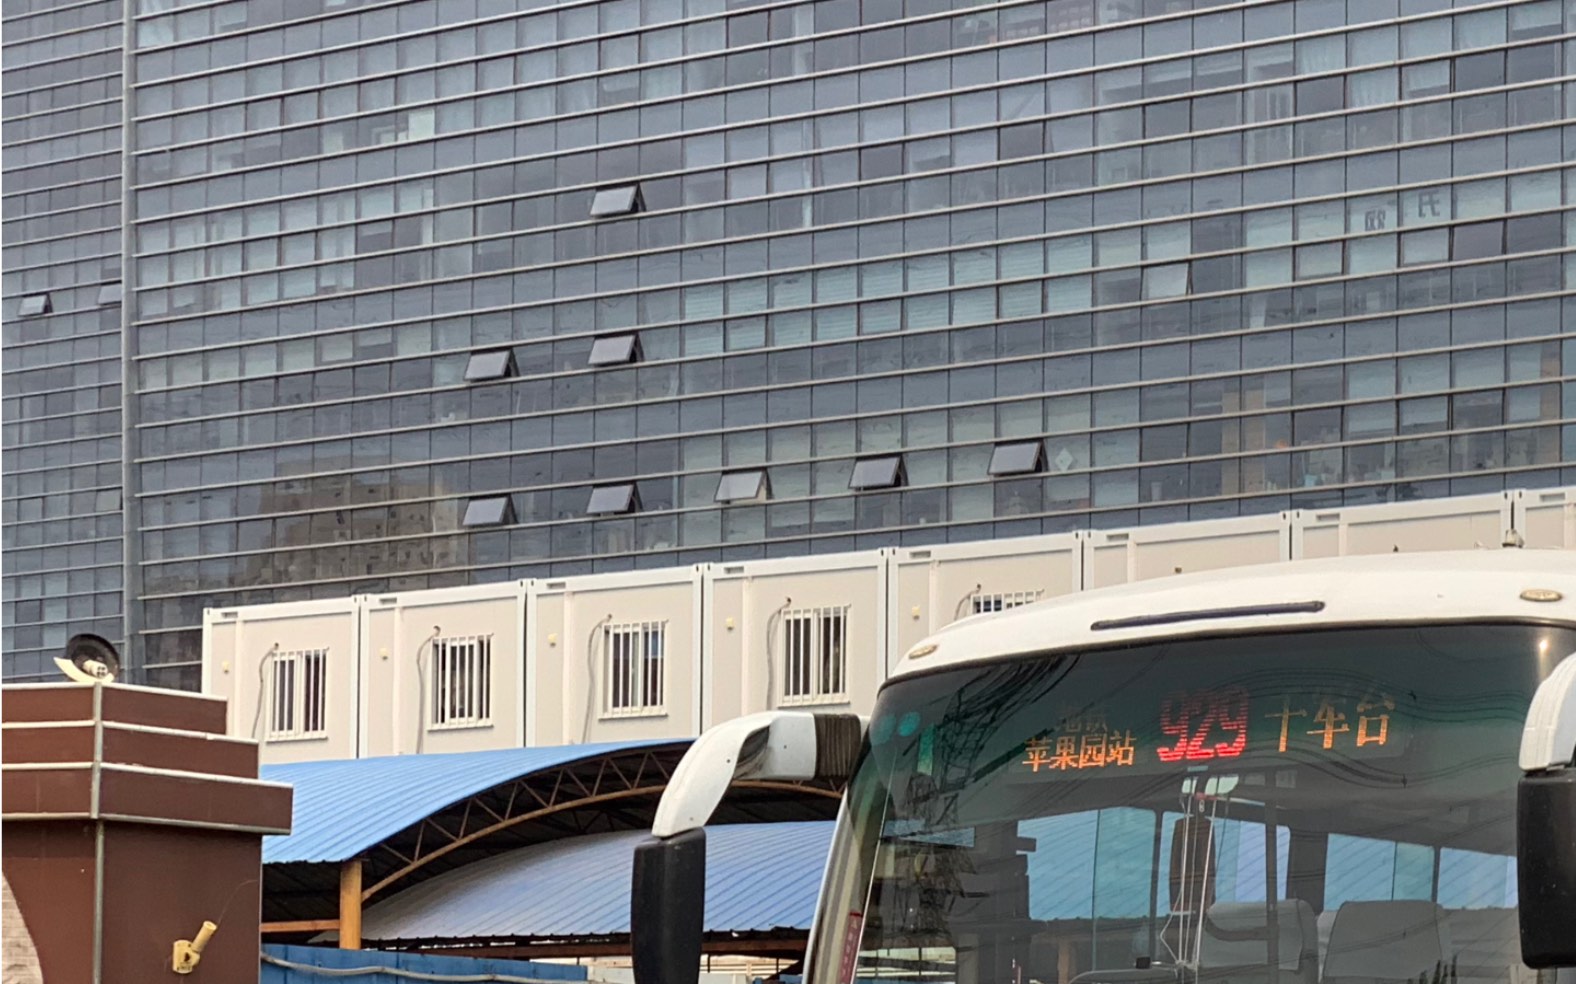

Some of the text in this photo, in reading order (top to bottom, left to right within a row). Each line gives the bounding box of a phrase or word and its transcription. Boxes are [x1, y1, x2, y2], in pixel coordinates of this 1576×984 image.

[1022, 730, 1137, 772] 苹果园站
[1157, 689, 1248, 761] 929
